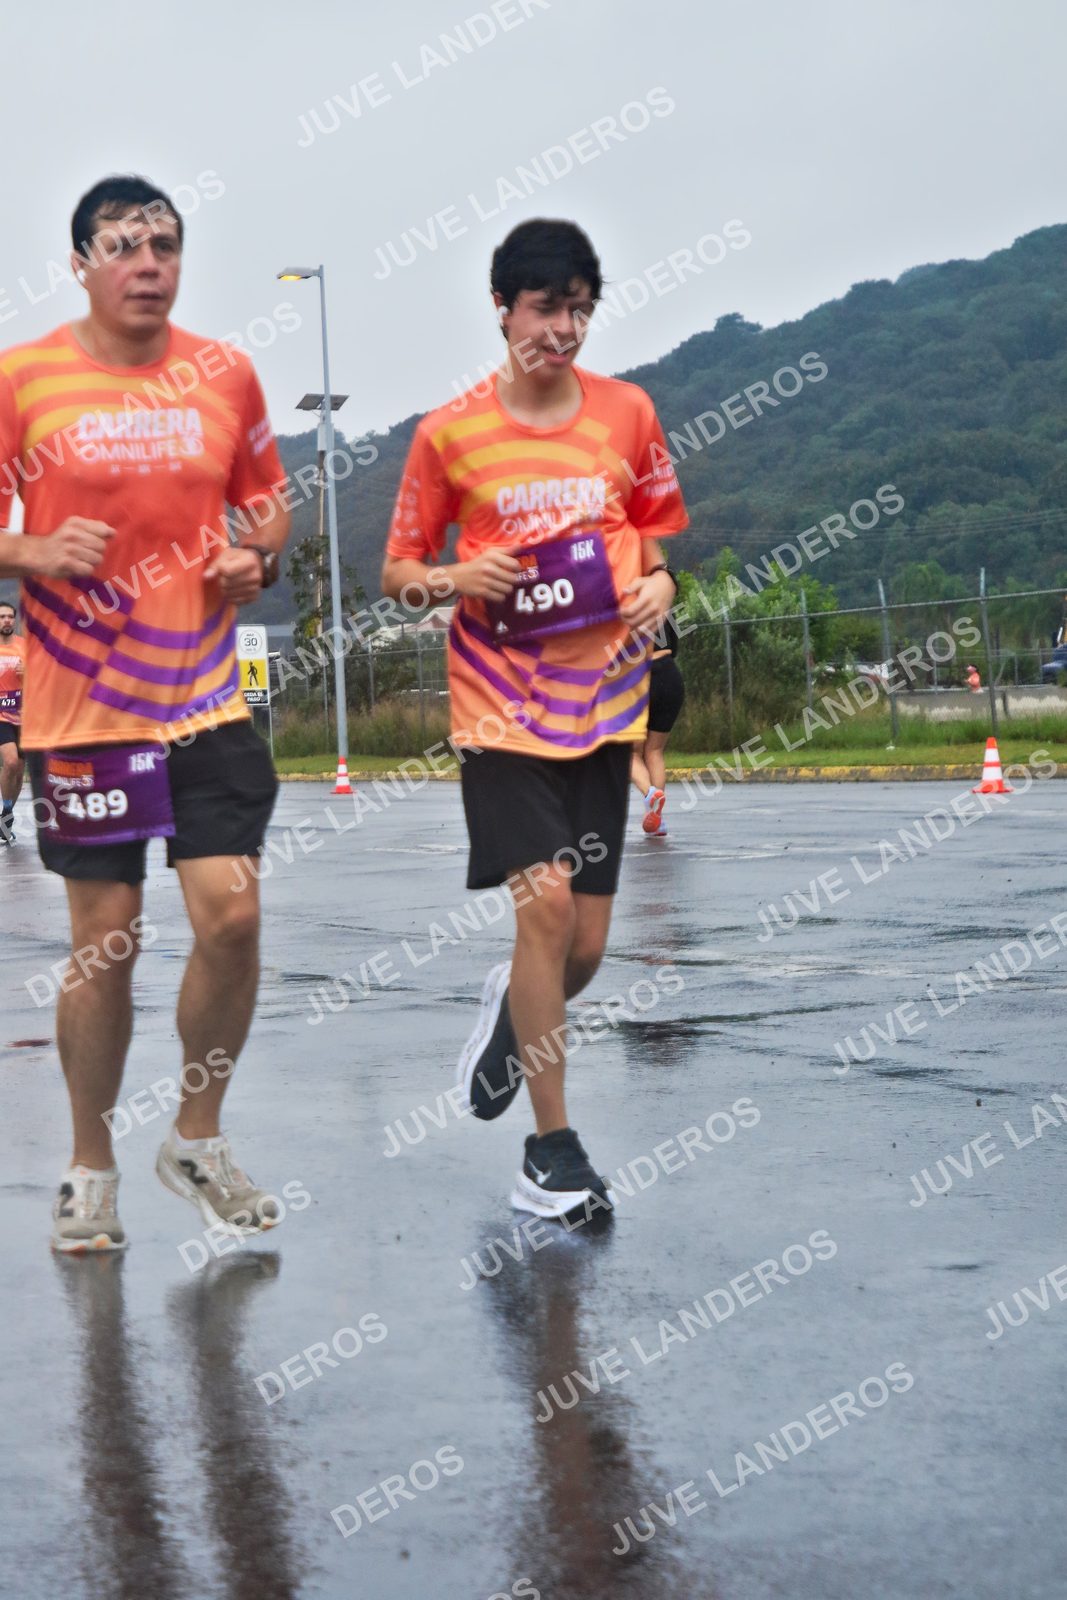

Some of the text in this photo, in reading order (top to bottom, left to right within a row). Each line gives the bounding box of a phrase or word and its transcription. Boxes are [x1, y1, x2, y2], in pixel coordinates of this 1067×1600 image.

[79, 408, 203, 441] CARRERA
[80, 439, 178, 465] OMNILIFE
[497, 477, 605, 516] CARRERA
[570, 538, 595, 561] 15K
[515, 578, 574, 614] 490
[244, 637, 258, 647] 30
[128, 751, 156, 773] 15K
[68, 789, 128, 819] 489
